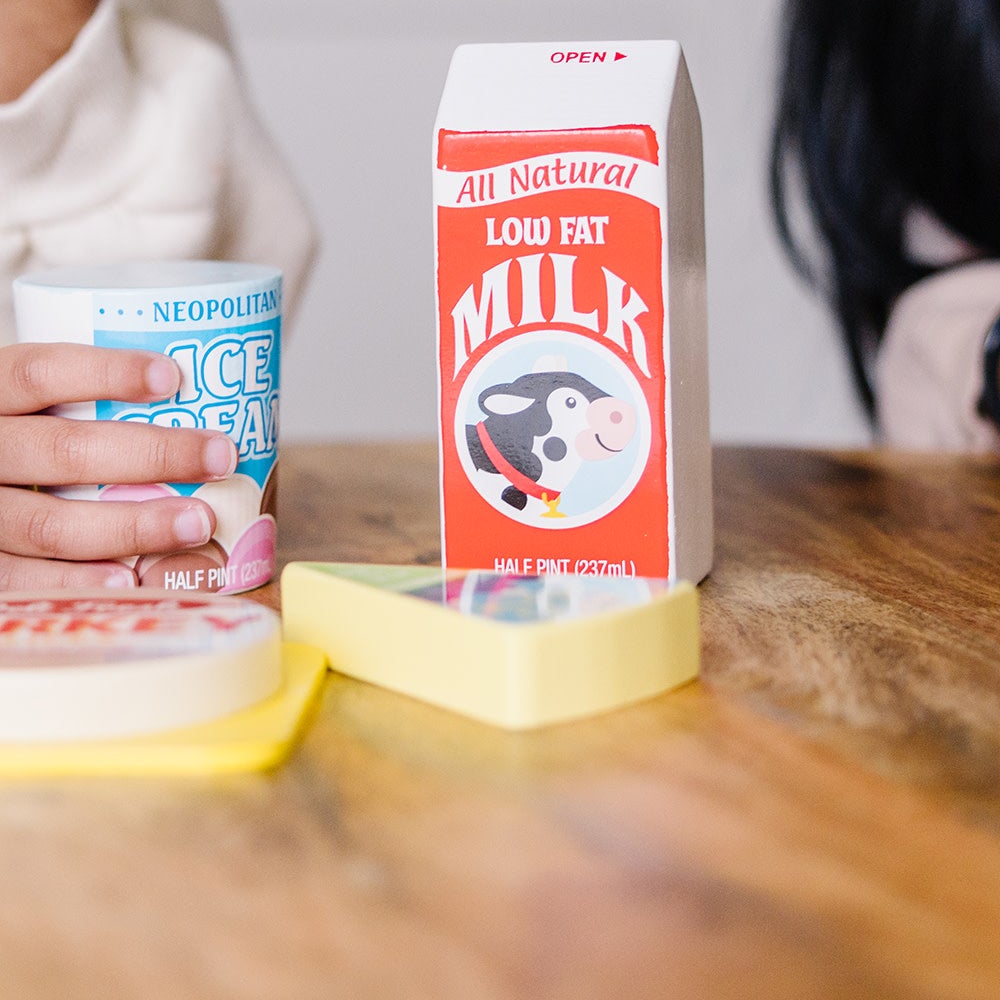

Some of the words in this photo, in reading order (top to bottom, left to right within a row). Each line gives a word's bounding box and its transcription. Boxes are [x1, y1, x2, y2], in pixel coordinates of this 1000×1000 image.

[550, 51, 606, 64] OPEN
[456, 172, 495, 204] All
[510, 157, 639, 196] Natural
[485, 215, 551, 246] LOW
[559, 215, 609, 245] FAT
[153, 290, 277, 322] NEOPOLITAN
[450, 252, 652, 382] MILK
[168, 333, 272, 404] ICE
[164, 569, 204, 590] HALF
[207, 565, 237, 588] PINT
[494, 557, 532, 576] HALF
[536, 558, 570, 577] PINT
[574, 558, 636, 580] (237mL)
